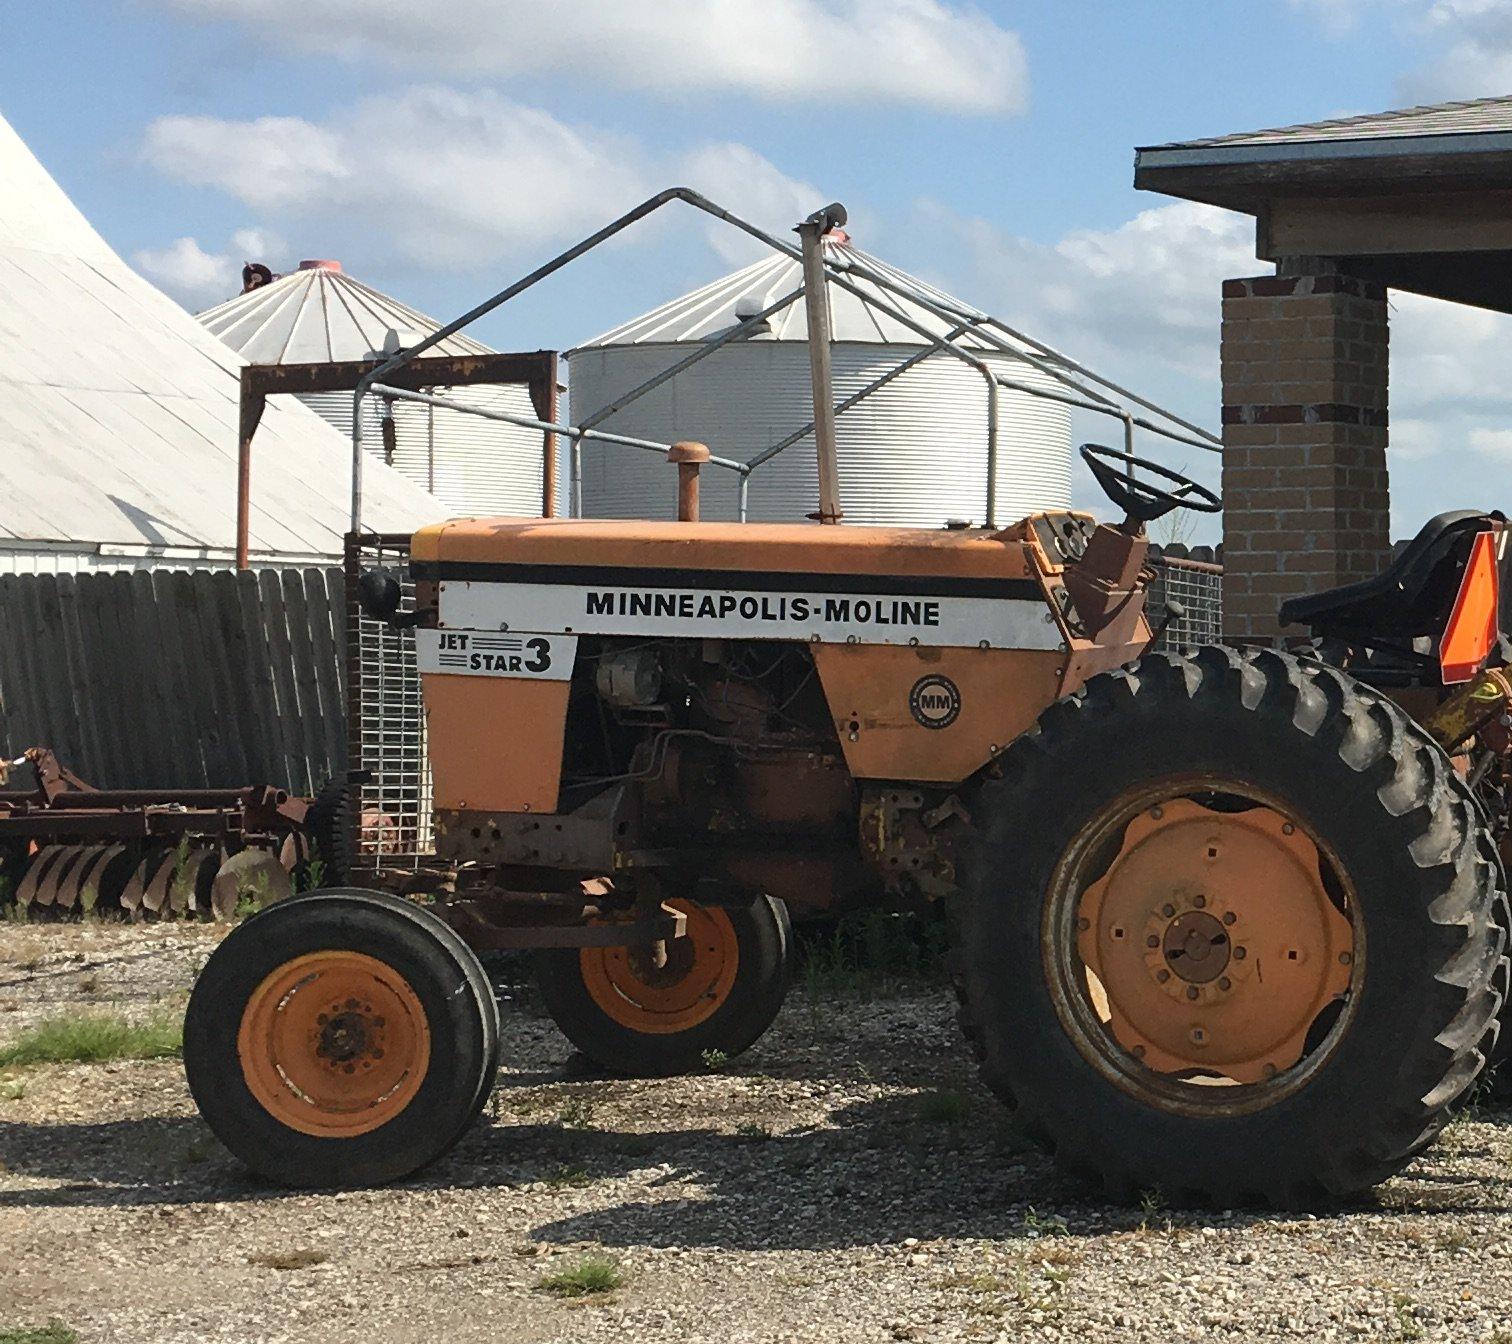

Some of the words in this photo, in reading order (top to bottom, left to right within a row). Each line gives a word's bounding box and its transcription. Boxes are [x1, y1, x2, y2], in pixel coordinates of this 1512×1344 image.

[586, 592, 940, 626] MINNEAPOLIS-MOLINE
[438, 634, 469, 650] JET
[470, 653, 522, 672] STAR
[525, 638, 552, 673] 3
[921, 695, 950, 709] MM
